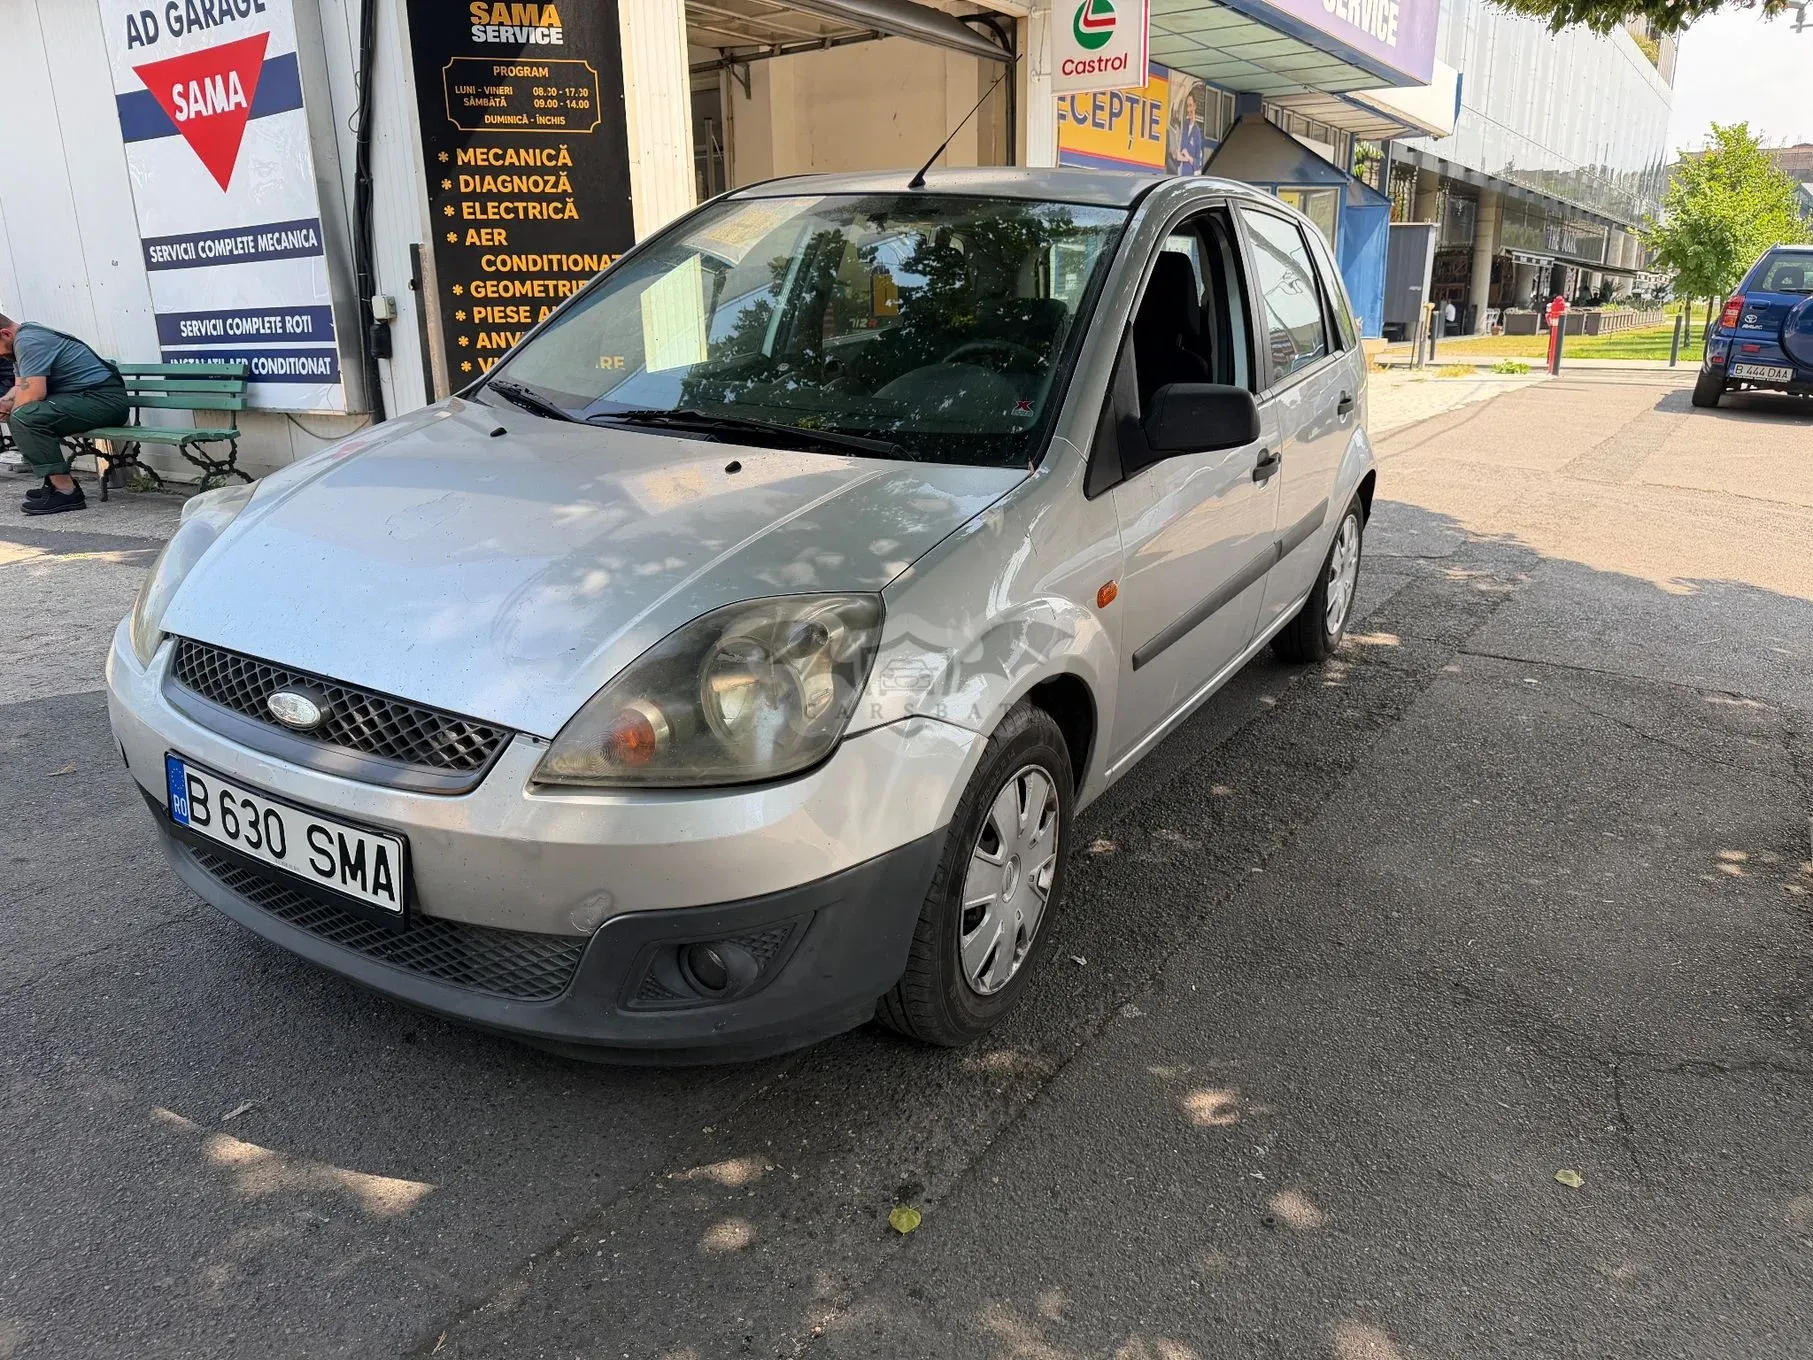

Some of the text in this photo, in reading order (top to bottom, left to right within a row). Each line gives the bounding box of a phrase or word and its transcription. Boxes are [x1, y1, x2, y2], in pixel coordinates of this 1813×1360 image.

[469, 1, 562, 27] SAMA
[126, 9, 160, 50] AD
[471, 25, 564, 45] SERVICE
[493, 66, 549, 78] PROGRAM
[1062, 52, 1128, 76] Castrol
[172, 70, 248, 122] SAMA
[455, 85, 476, 94] LUNI
[484, 86, 513, 95] VINERI
[463, 96, 508, 108] SÂMBĂTĂ
[533, 99, 558, 108] 09.00
[566, 100, 590, 109] 14.00
[484, 114, 529, 125] DUMINICĂ
[536, 114, 566, 125] ÎNCHIS
[456, 144, 573, 167] MECANICĂ
[459, 171, 573, 193] DIAGNOZĂ
[461, 197, 580, 220] ELECTRICĂ
[150, 228, 318, 263] SERVICII COMPLETE MECANICA
[465, 228, 509, 246] AER
[473, 306, 532, 323] PIESE
[180, 315, 313, 337] SERVICII COMPLETE ROTI
[252, 357, 331, 375] CONDITIONAT
[1735, 365, 1788, 379] B 444 DAA
[174, 794, 188, 817] RO
[186, 773, 396, 902] B 630 SMA
